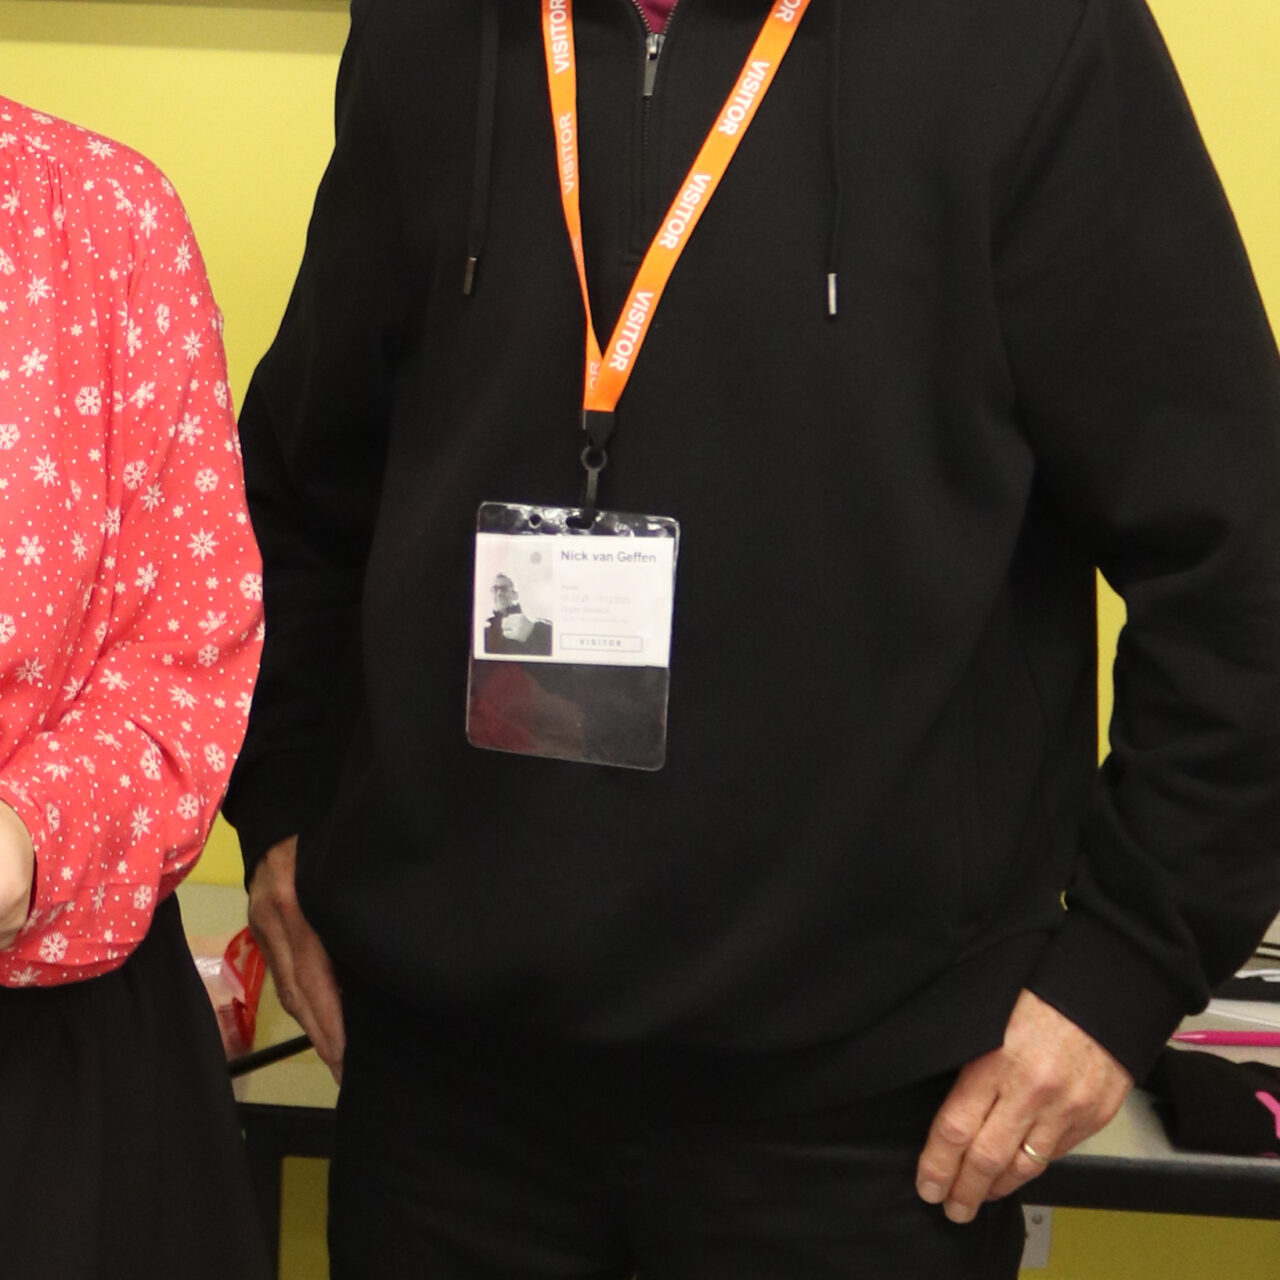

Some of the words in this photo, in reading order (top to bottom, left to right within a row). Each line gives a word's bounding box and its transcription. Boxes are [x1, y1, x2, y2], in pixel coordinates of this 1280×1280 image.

[719, 60, 770, 137] VISITOR
[558, 112, 575, 195] VISITOR
[658, 173, 712, 252] VISITOR
[608, 290, 655, 372] VISITOR
[560, 550, 588, 561] Nick
[592, 552, 613, 563] van
[616, 551, 656, 564] Geffen
[579, 638, 622, 648] VISITOR
